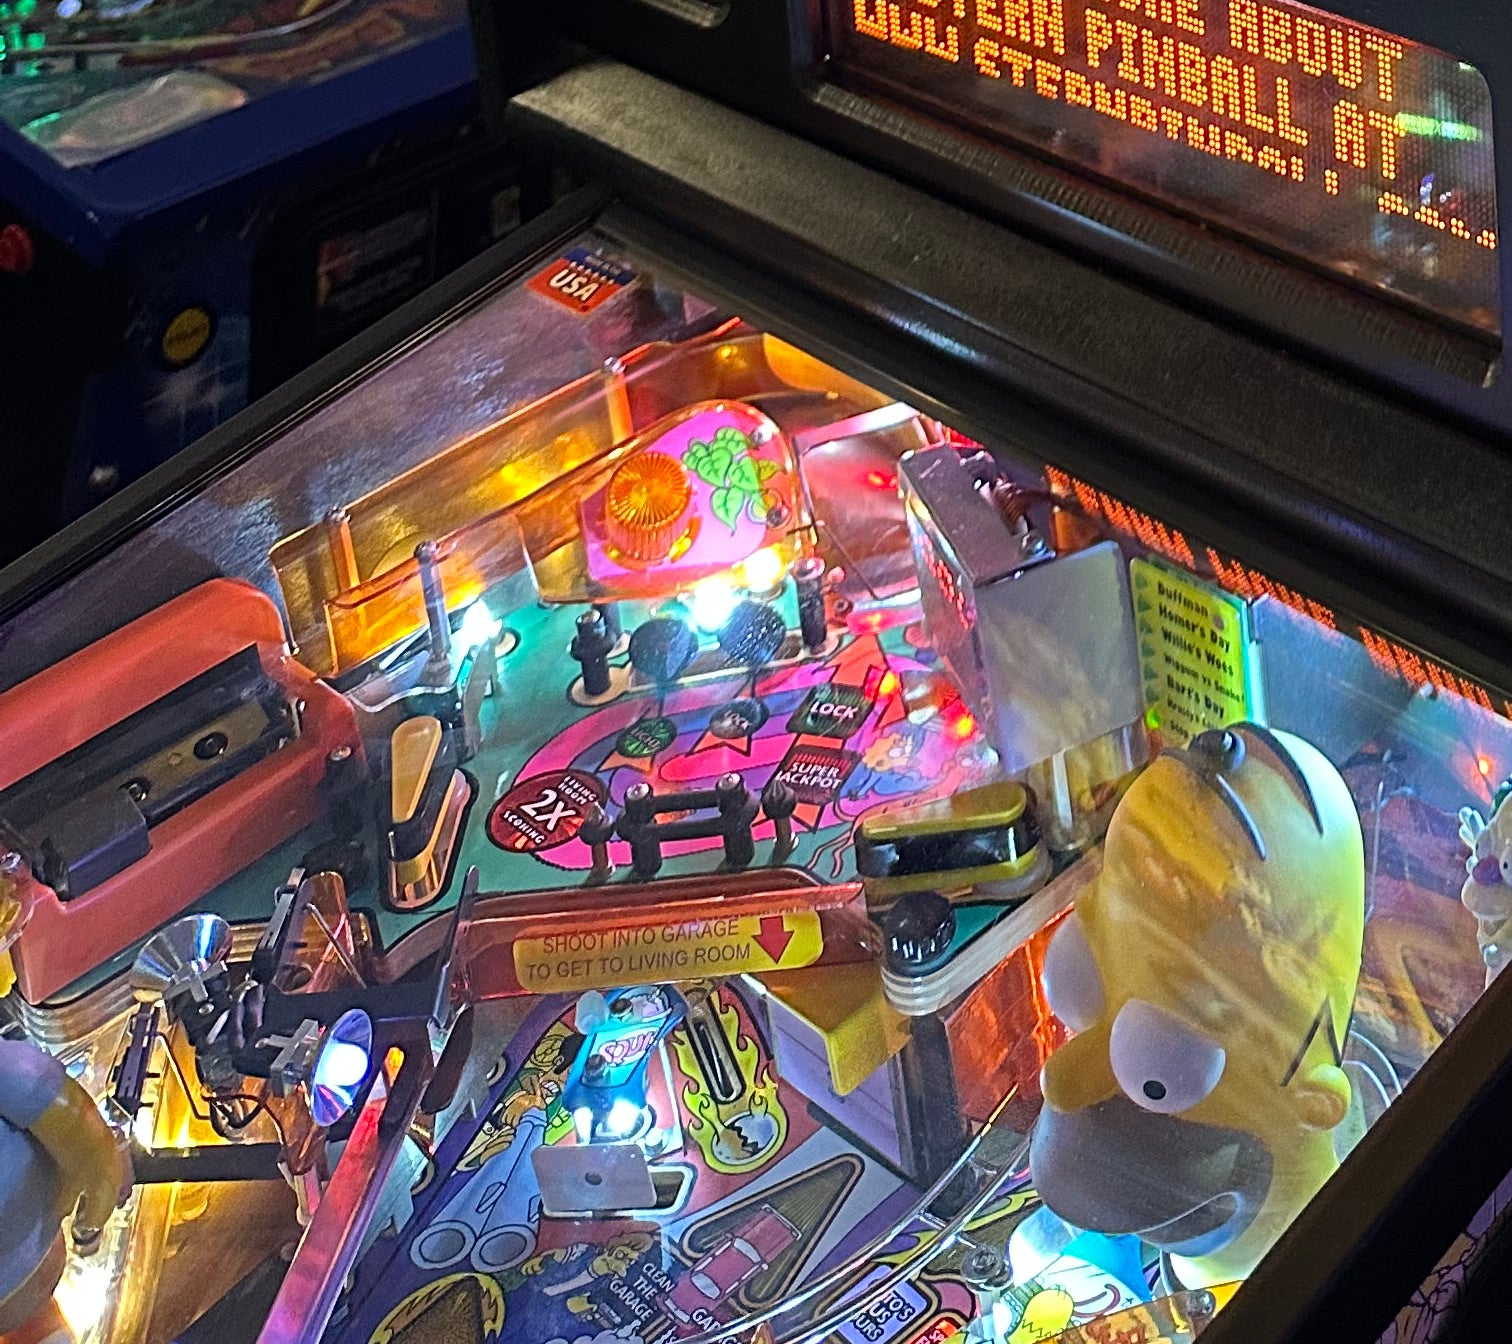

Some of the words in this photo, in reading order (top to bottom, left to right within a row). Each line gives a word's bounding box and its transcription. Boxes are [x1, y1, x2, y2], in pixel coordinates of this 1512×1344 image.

[1085, 7, 1309, 148] PINBALL
[1333, 98, 1407, 181] AT
[549, 268, 600, 302] USA
[1158, 603, 1206, 639] Homer's
[1210, 628, 1230, 654] Day
[809, 701, 859, 719] LOCK
[1167, 673, 1201, 704] Bart's
[1204, 693, 1225, 720] Day
[775, 770, 842, 789] JACKPOT
[790, 761, 840, 778] SUPER
[557, 782, 587, 805] ROOM
[563, 775, 597, 802] LIVING
[503, 810, 545, 844] SCORING
[520, 789, 577, 831] 2X
[543, 930, 610, 955] SHOOT
[613, 923, 657, 948] INTO
[661, 917, 740, 945] GARAGE
[527, 962, 552, 981] TO
[556, 958, 593, 979] GET
[600, 955, 625, 976] TO
[628, 949, 689, 972] LIVING
[694, 943, 751, 965] ROOM
[633, 1275, 658, 1301] THE
[642, 1262, 676, 1293] CLEAN
[609, 1279, 654, 1322] GARAGE
